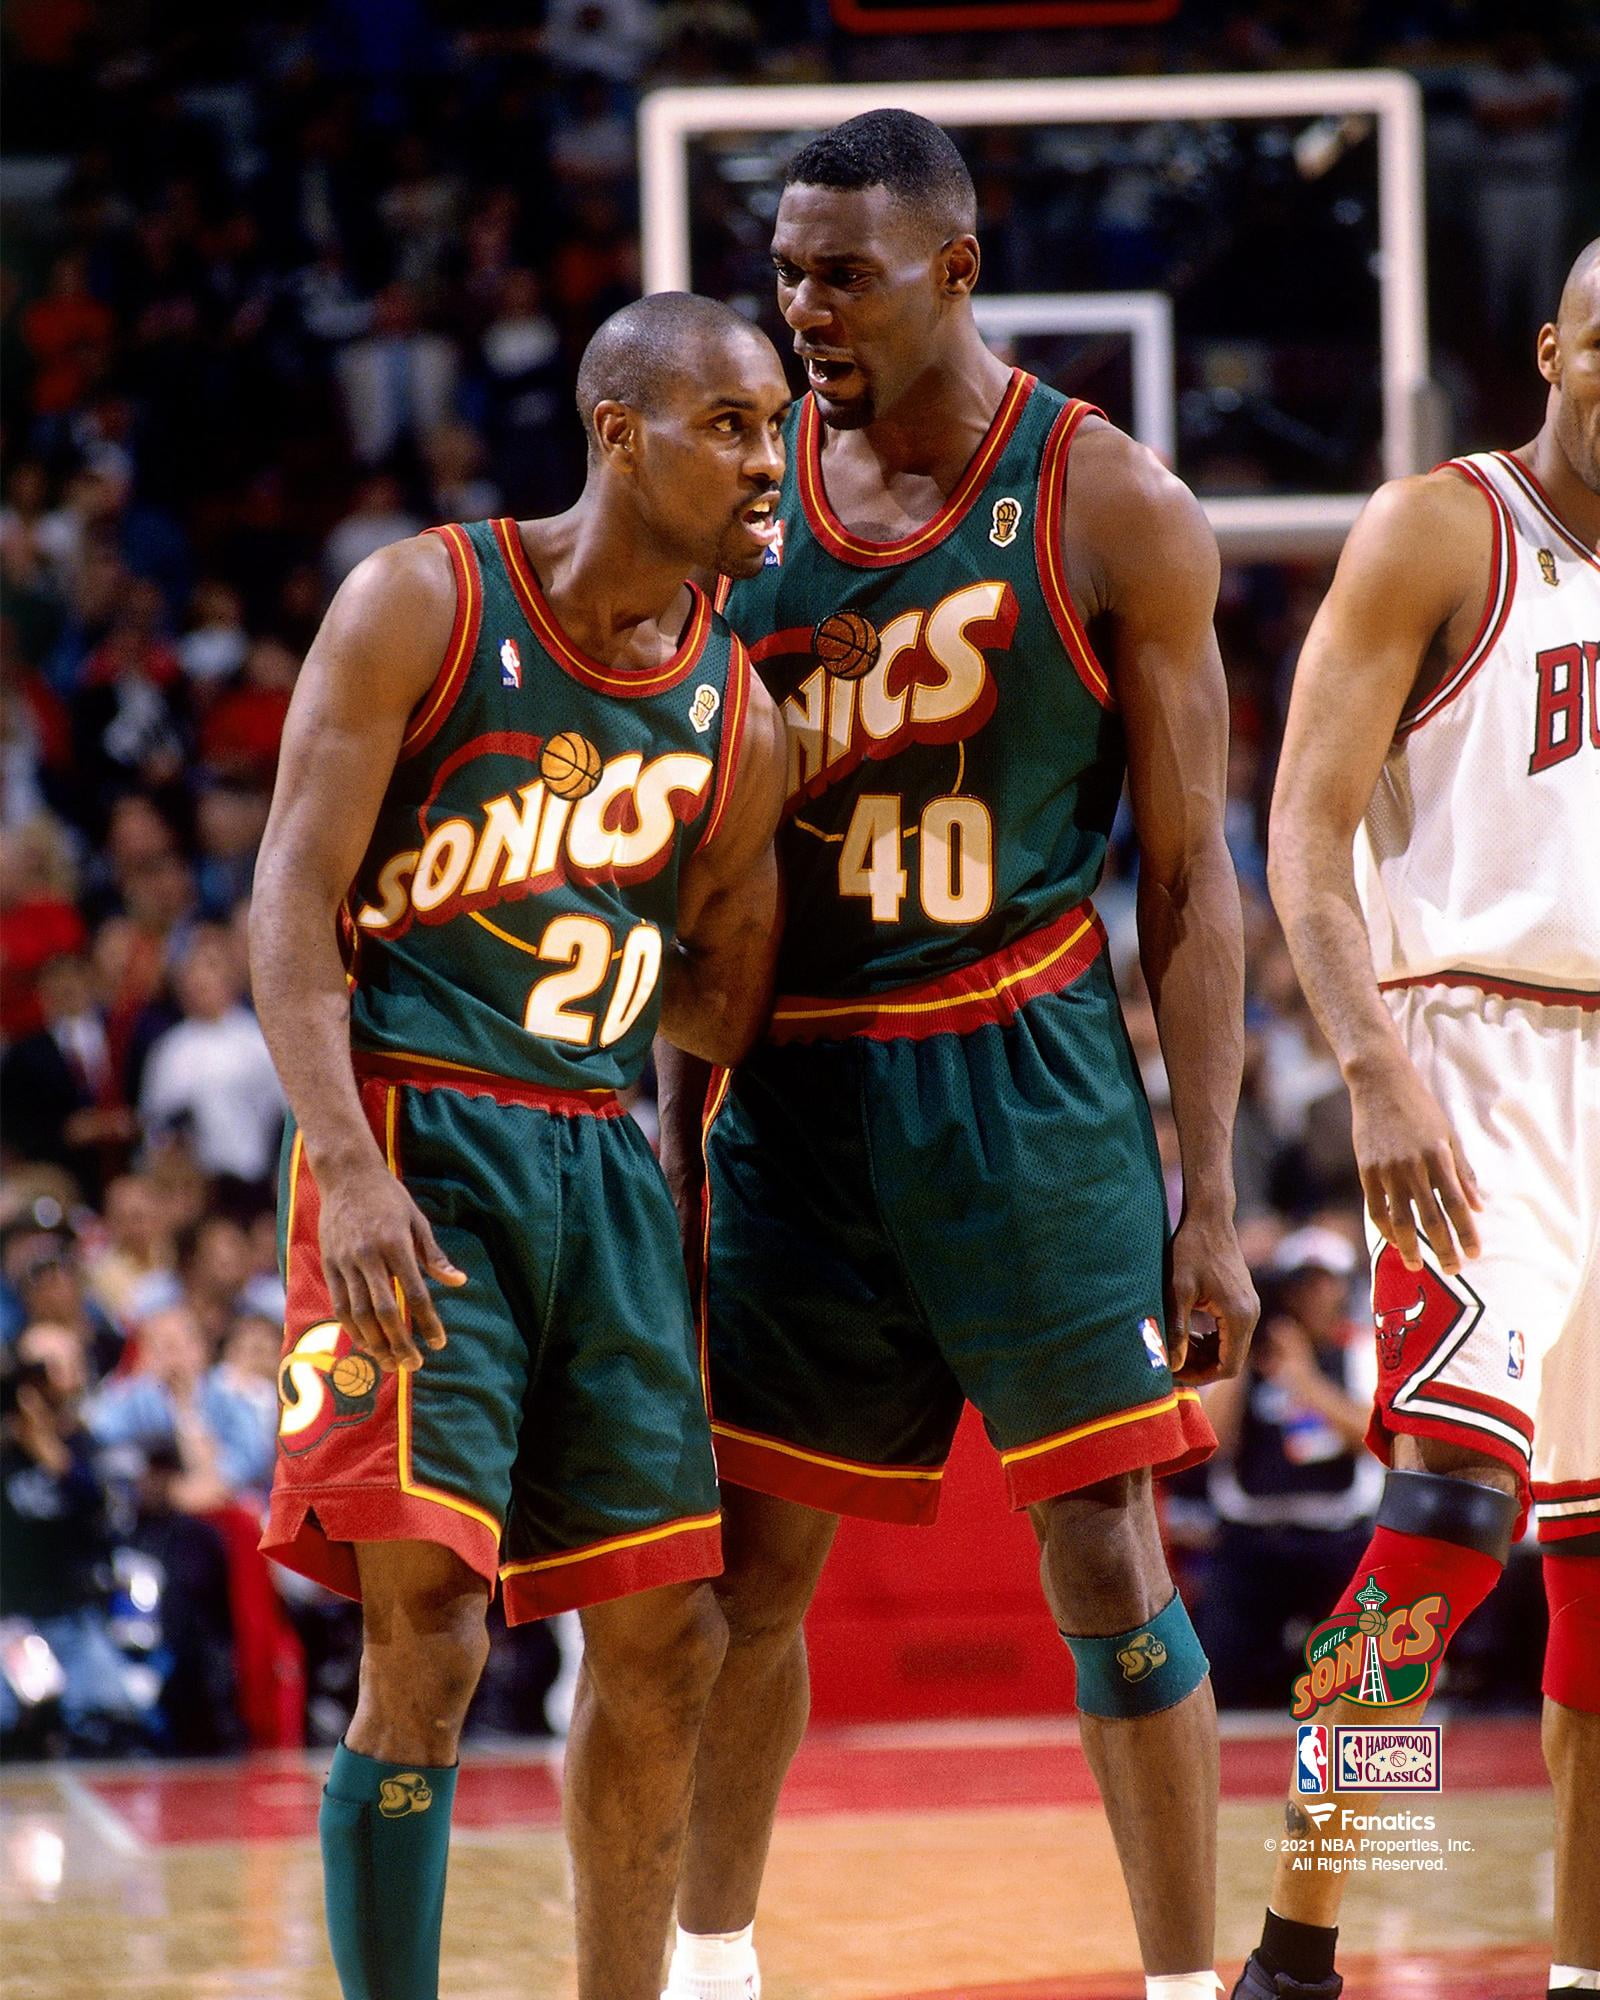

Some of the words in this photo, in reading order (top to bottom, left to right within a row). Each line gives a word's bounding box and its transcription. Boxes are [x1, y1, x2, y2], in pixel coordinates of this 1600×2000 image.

[787, 582, 1006, 798] NICS
[358, 752, 713, 929] SONICS
[839, 794, 992, 923] 40
[524, 914, 663, 1048] 20
